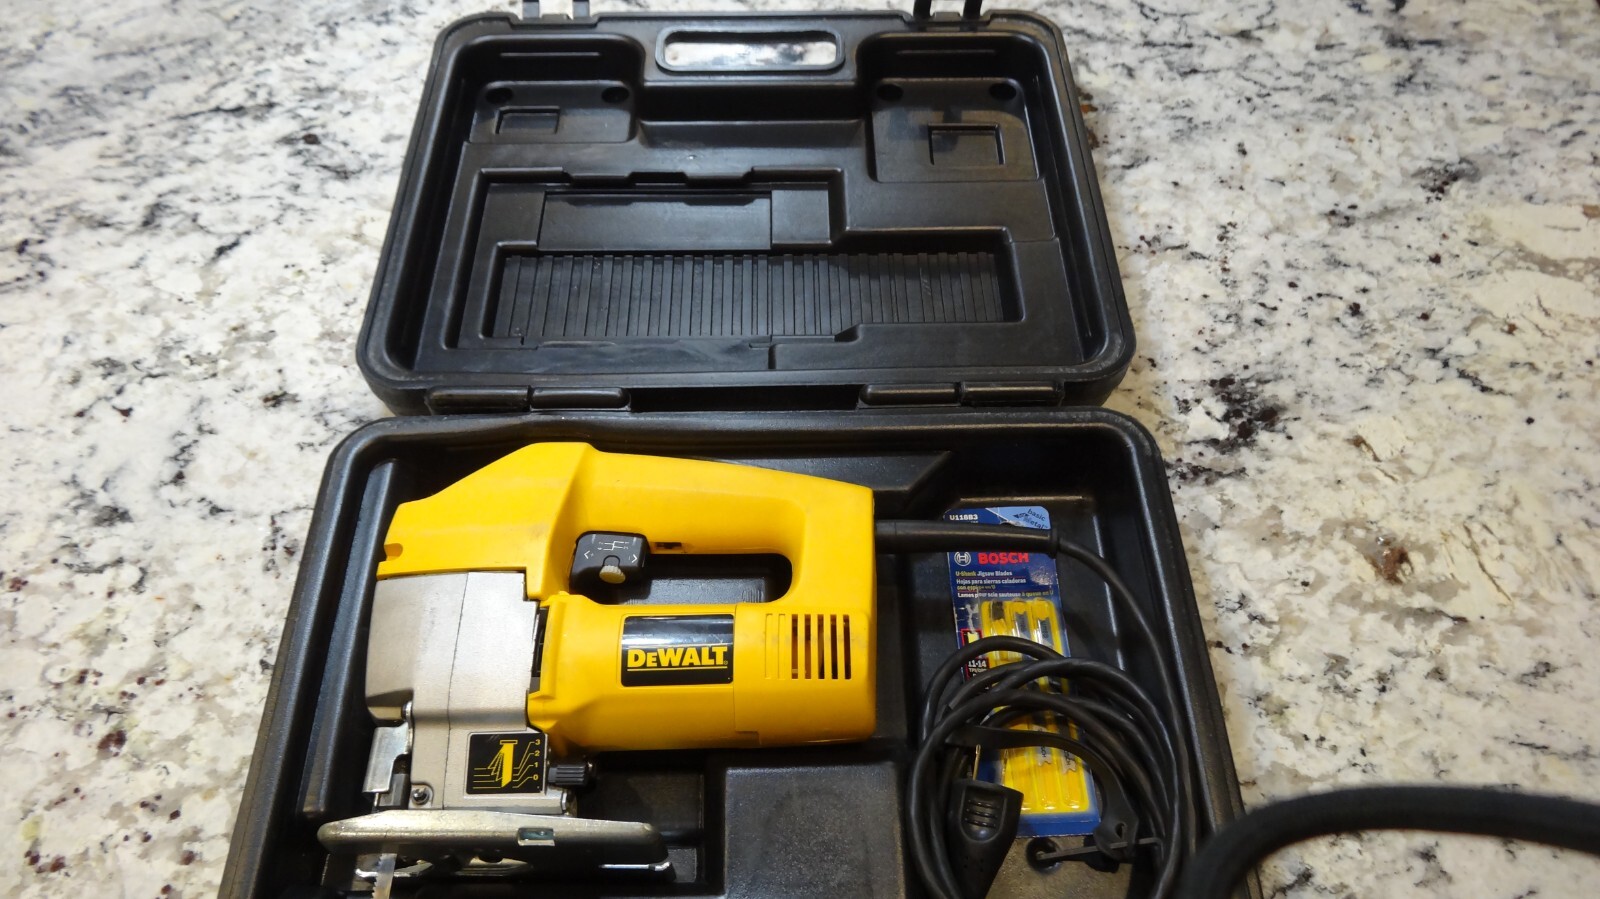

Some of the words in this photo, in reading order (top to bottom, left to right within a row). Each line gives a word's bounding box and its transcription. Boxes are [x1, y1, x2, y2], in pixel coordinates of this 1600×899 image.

[1027, 508, 1046, 521] basic
[977, 552, 1030, 566] BOSCH
[977, 570, 995, 578] Jigsaw
